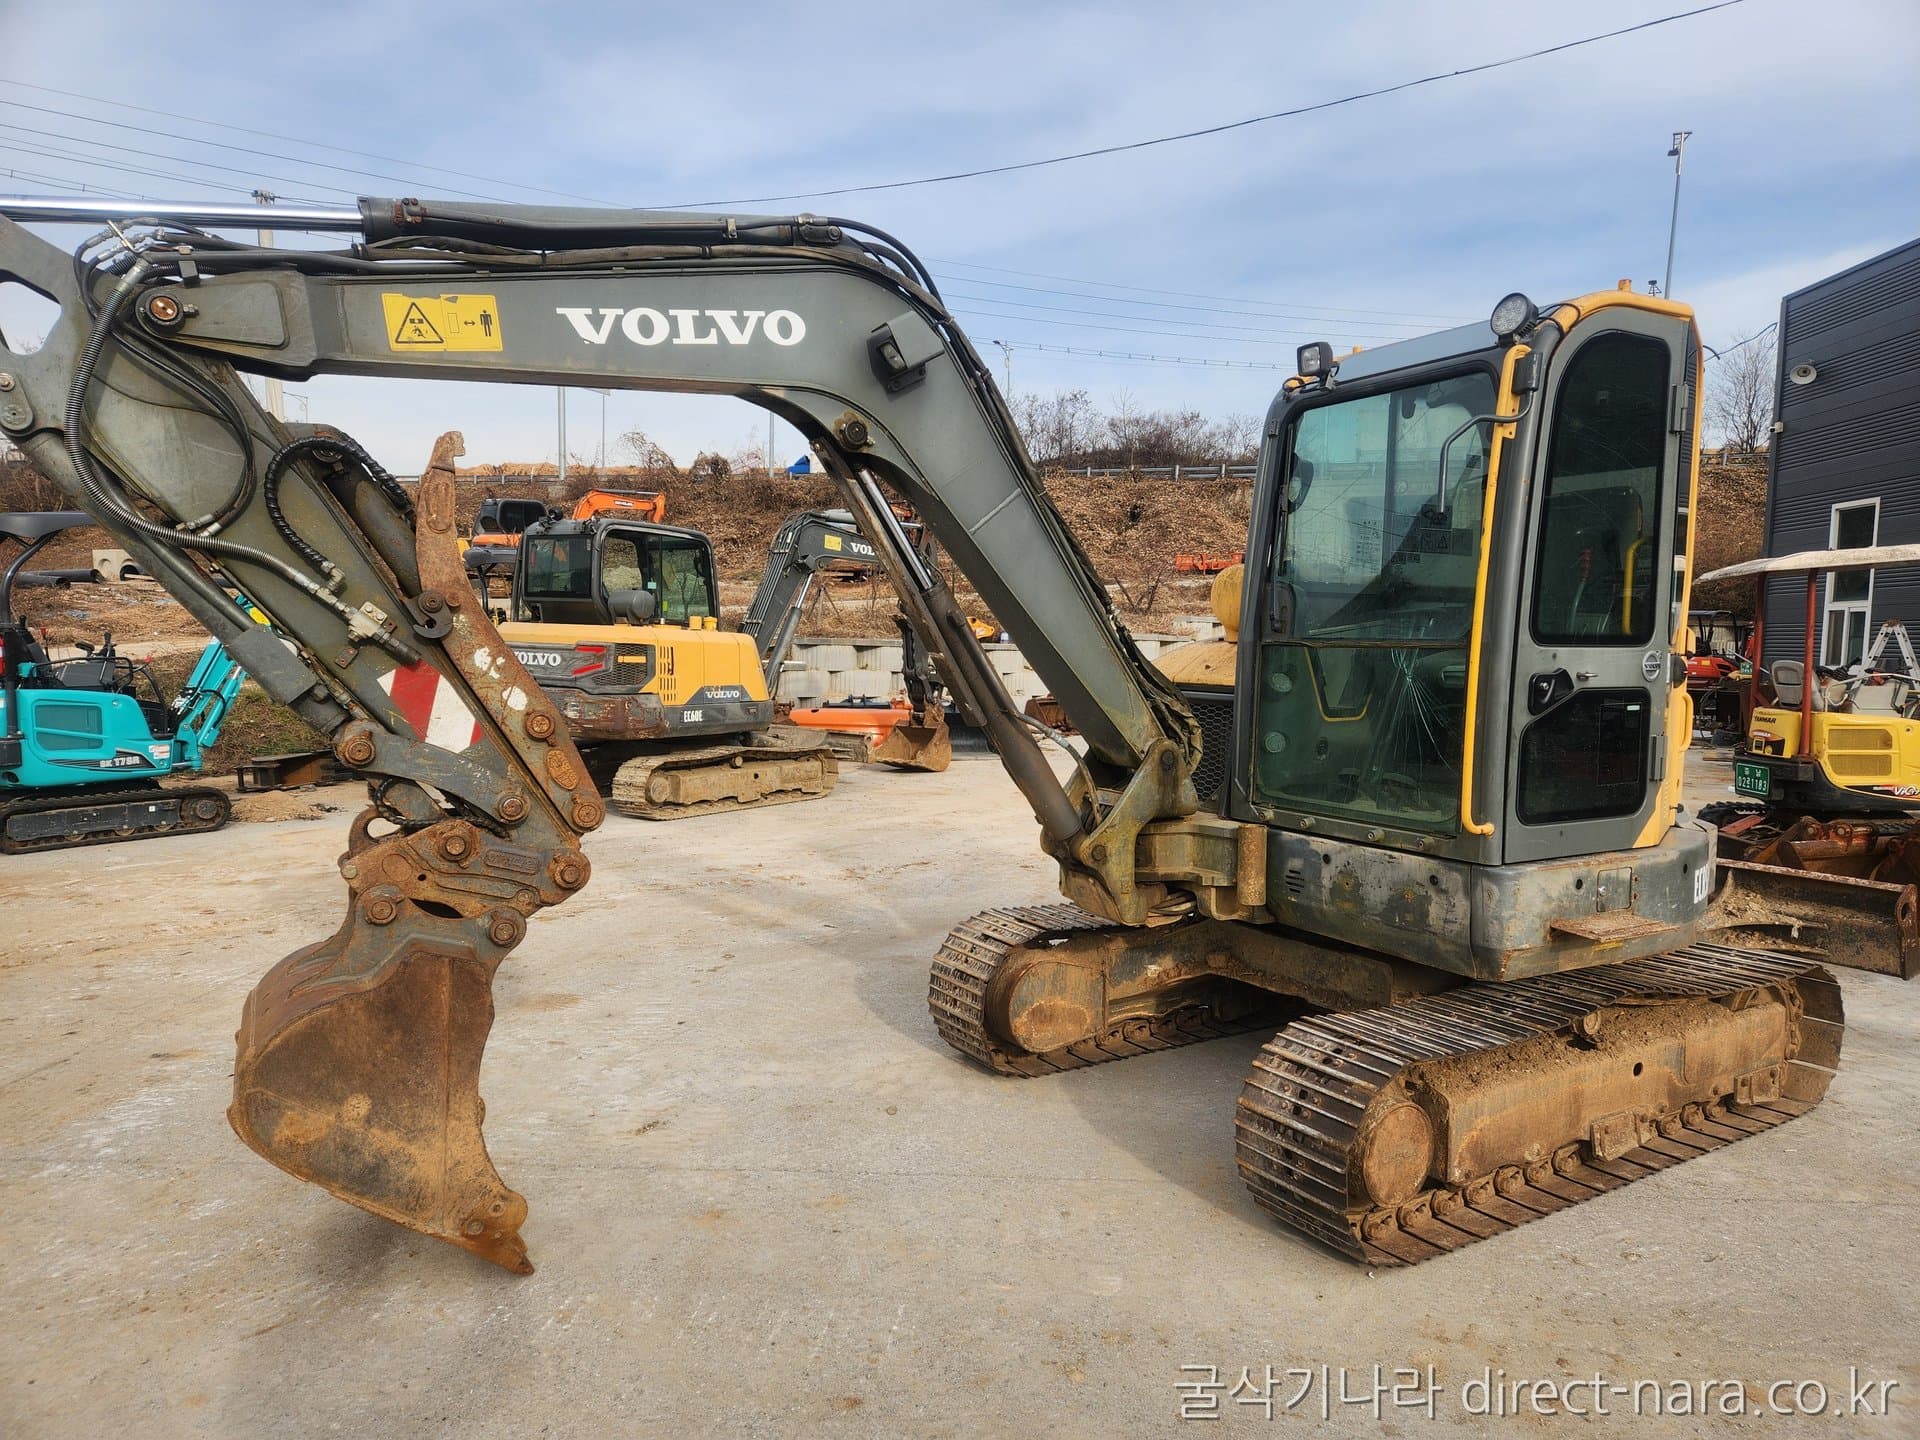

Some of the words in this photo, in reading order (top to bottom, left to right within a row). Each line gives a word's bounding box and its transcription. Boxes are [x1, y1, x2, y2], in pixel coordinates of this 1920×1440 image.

[556, 307, 807, 346] VOLVO
[850, 542, 876, 556] VOL
[705, 690, 740, 699] VOLVO
[683, 710, 704, 723] EC60E
